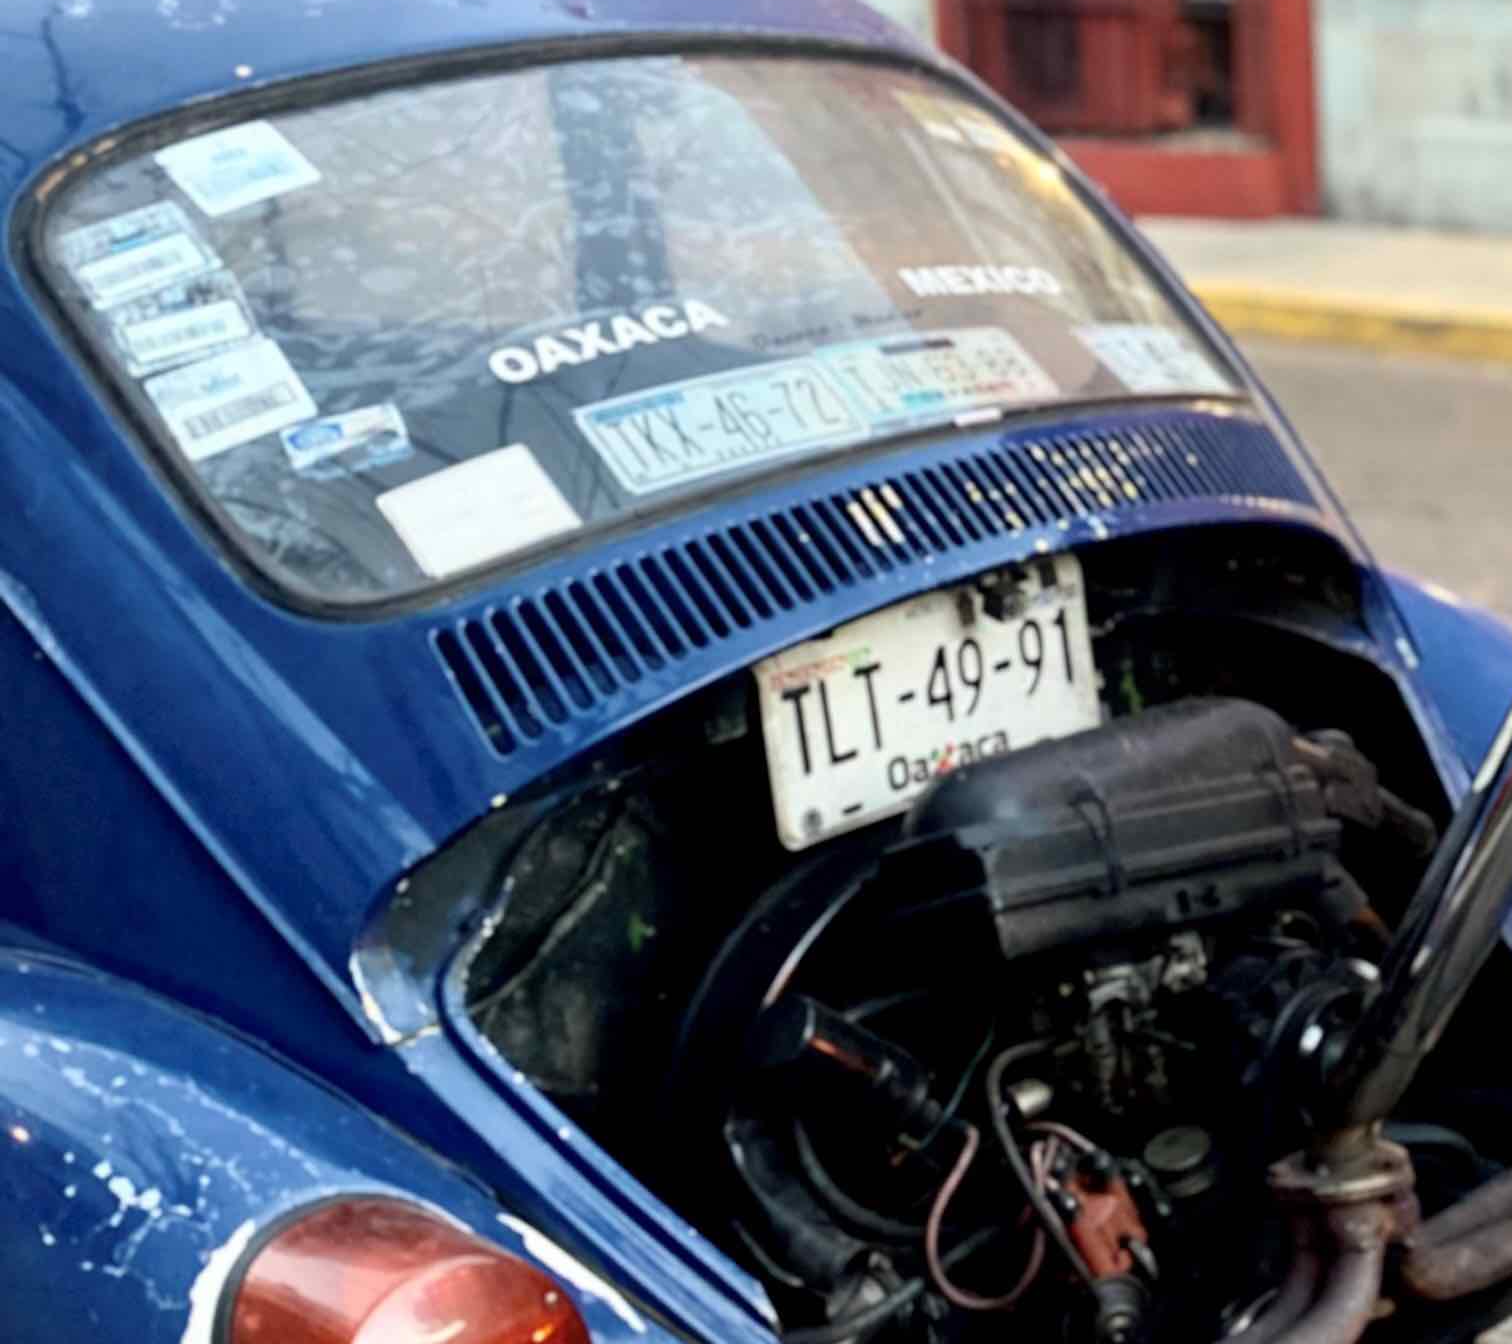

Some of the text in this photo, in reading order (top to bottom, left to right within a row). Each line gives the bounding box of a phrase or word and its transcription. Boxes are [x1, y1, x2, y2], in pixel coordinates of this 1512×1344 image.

[898, 265, 1061, 297] MEXICO
[488, 299, 730, 384] OAXACA
[780, 607, 1077, 776] TLT-49-91
